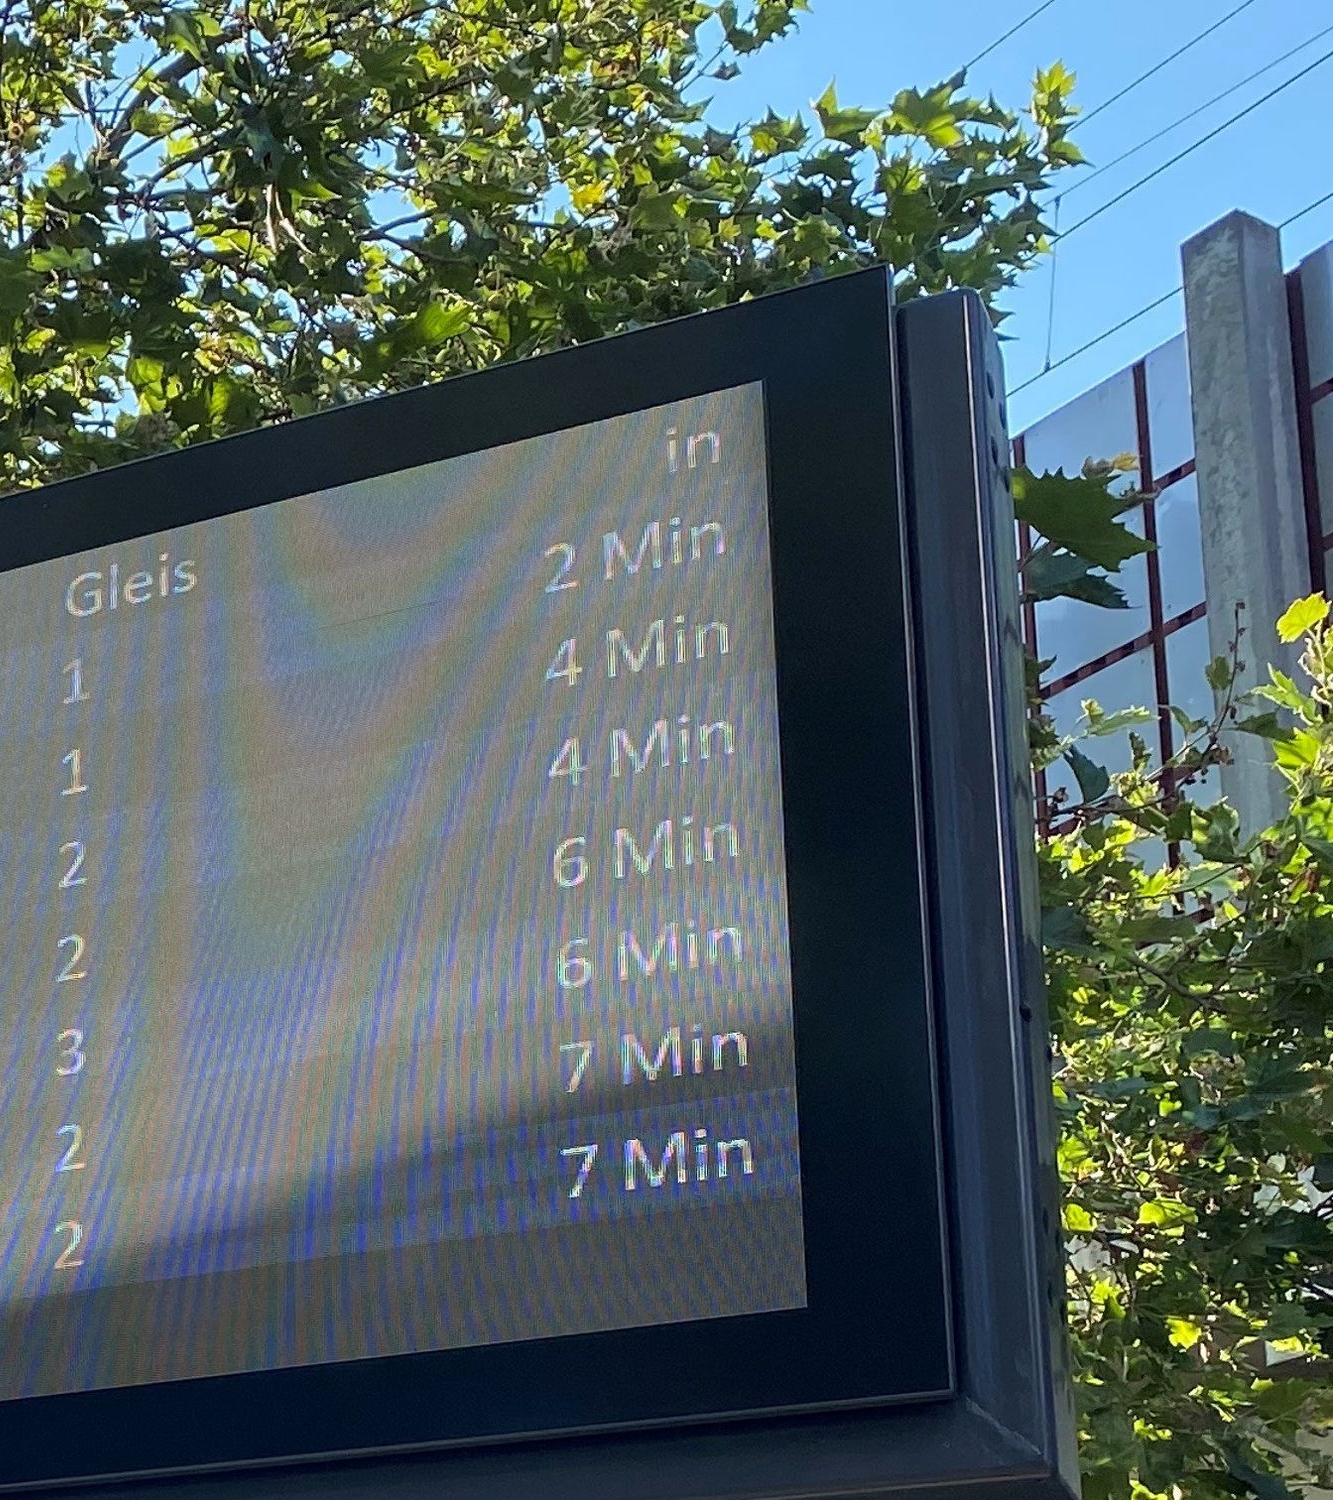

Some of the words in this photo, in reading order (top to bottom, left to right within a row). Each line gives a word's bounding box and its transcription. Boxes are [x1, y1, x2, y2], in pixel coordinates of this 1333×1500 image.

[666, 424, 721, 473] in
[62, 658, 91, 704] 1
[545, 544, 579, 594] 2
[603, 515, 727, 581] Min
[66, 553, 198, 618] Gleis
[60, 748, 89, 796] 1
[547, 638, 583, 686] 4
[606, 612, 730, 678] Min
[58, 842, 87, 889] 2
[548, 736, 586, 787] 4
[610, 714, 735, 778] Min
[56, 935, 87, 982] 2
[552, 836, 589, 888] 6
[613, 816, 740, 879] Min
[56, 1029, 85, 1078] 3
[556, 937, 593, 989] 6
[617, 919, 743, 980] Min
[56, 1124, 85, 1173] 2
[559, 1041, 596, 1093] 7
[621, 1022, 749, 1083] Min
[54, 1221, 85, 1271] 2
[561, 1144, 597, 1198] 7
[624, 1126, 755, 1191] Min
